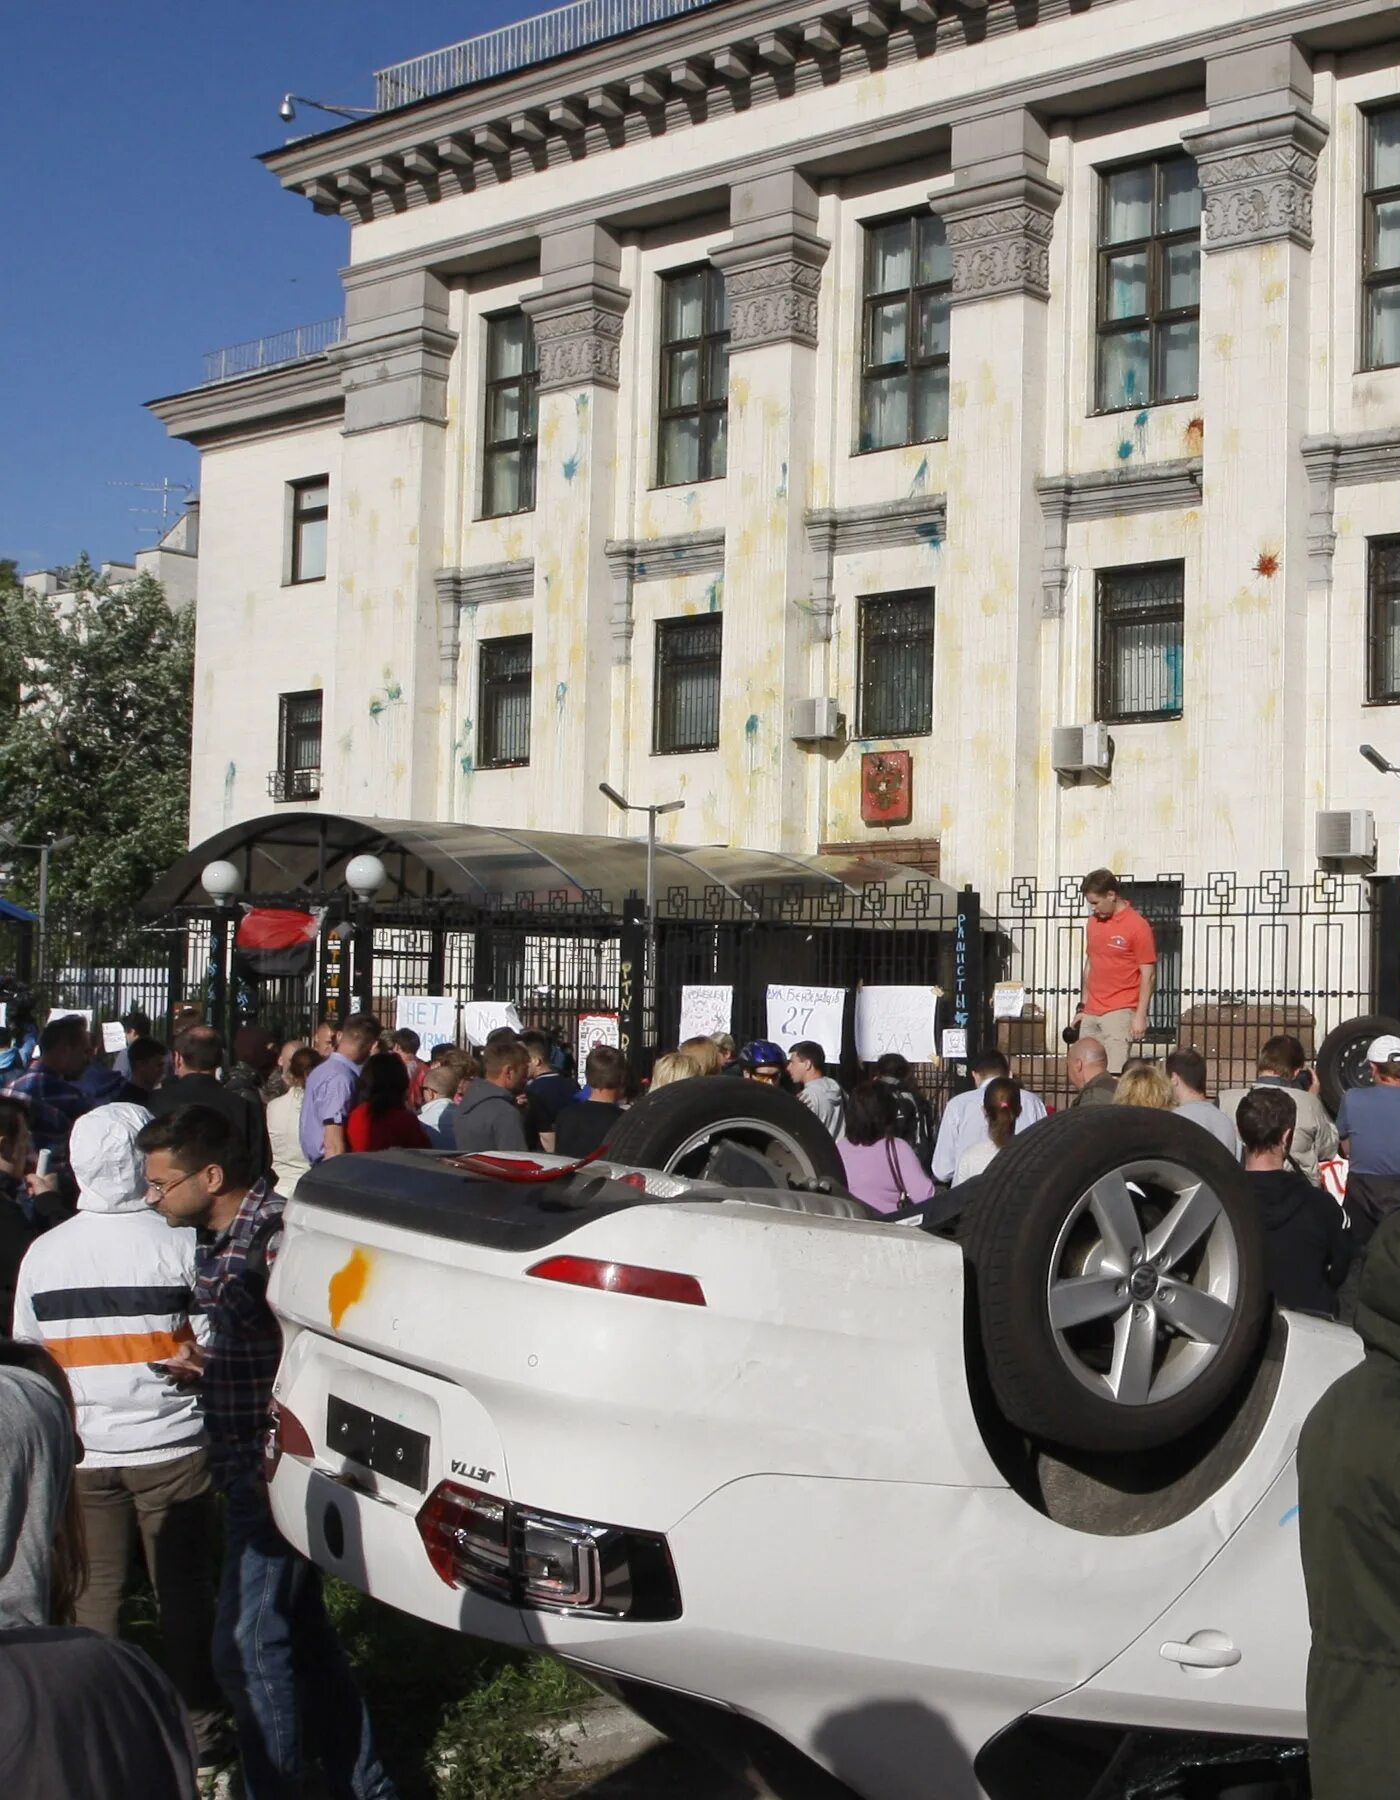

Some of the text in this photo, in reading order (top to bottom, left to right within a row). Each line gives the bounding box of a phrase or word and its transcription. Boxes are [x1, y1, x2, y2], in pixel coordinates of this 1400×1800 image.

[406, 1002, 443, 1026] НЕТ
[781, 1006, 814, 1036] 27
[451, 1459, 496, 1484] JETTA
